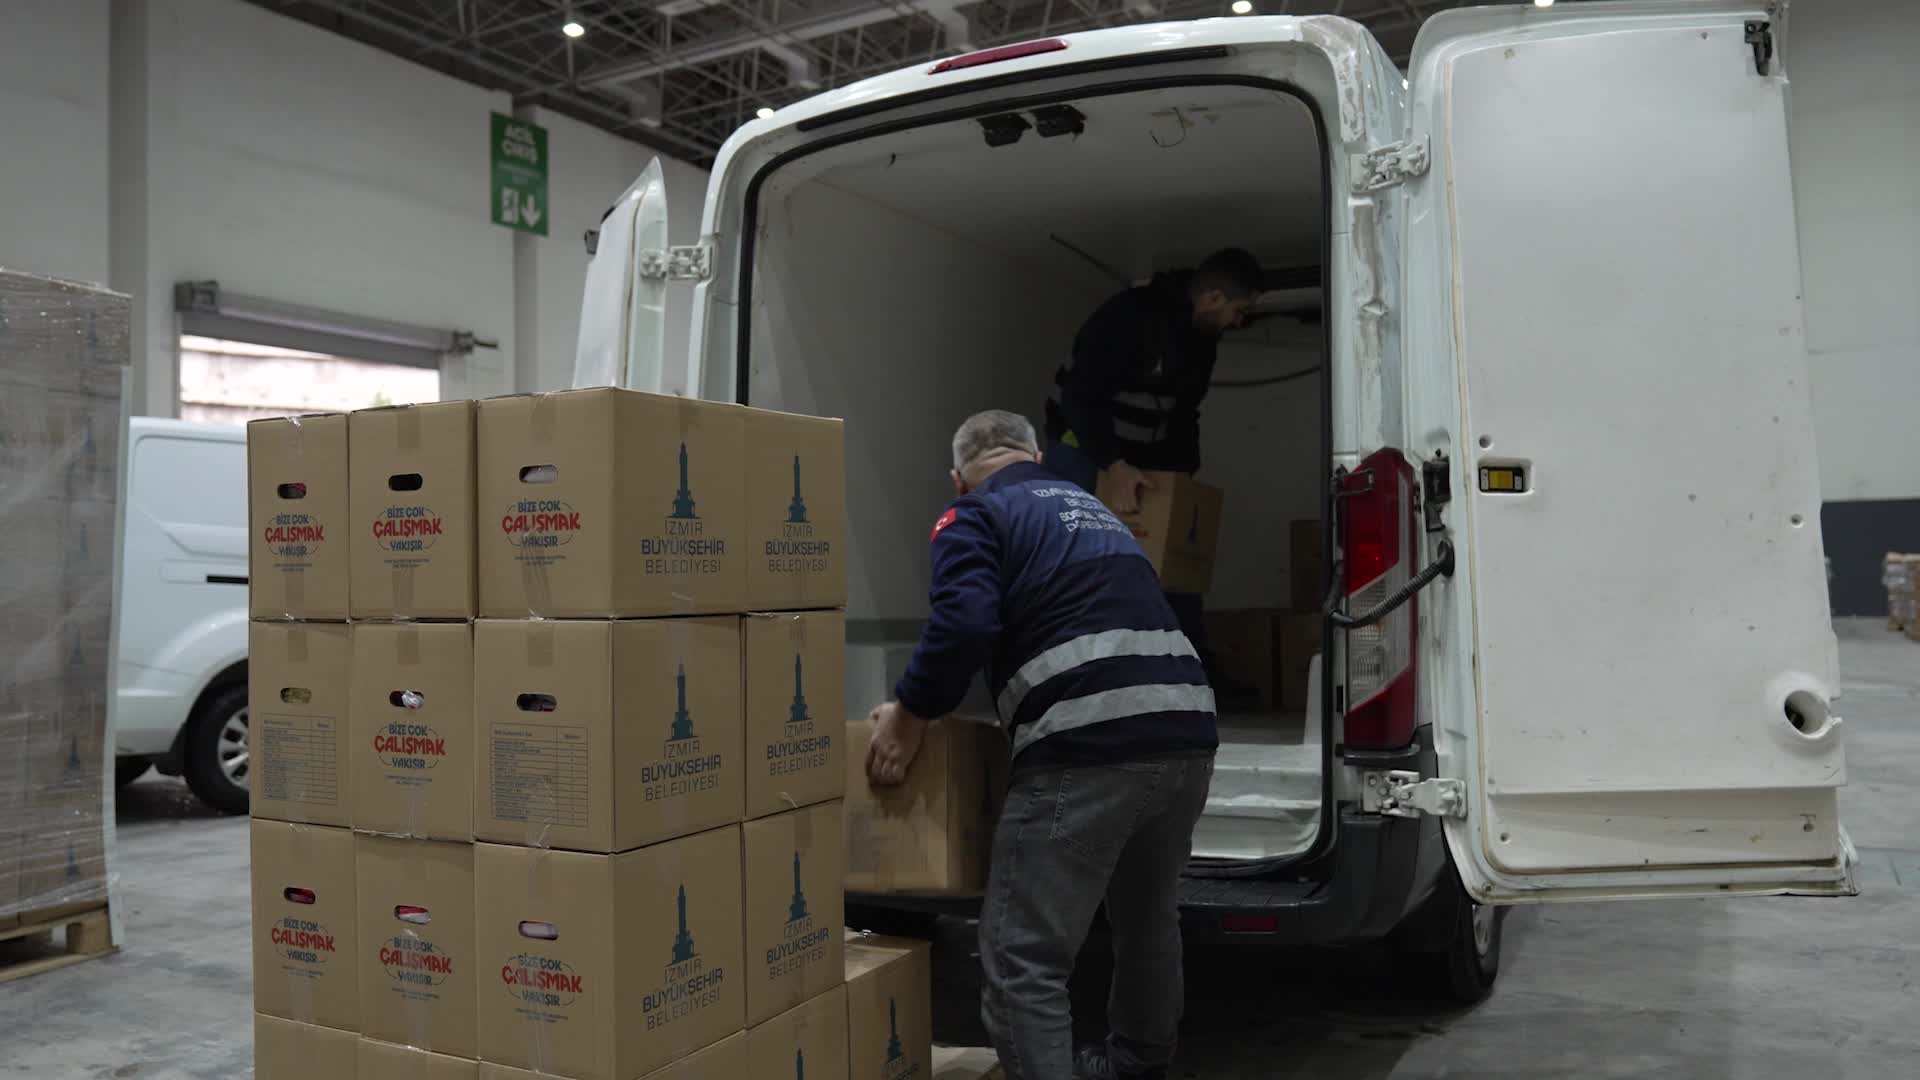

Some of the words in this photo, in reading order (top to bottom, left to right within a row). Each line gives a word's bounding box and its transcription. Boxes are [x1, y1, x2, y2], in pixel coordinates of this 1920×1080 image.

[641, 536, 725, 556] BÜYÜKŞEHİR
[765, 538, 830, 557] BÜYÜKŞEHİR
[767, 735, 831, 760] BÜYÜKŞEHİR
[641, 754, 721, 784] BÜYÜKŞEHİR
[642, 967, 724, 1014] BÜYÜKŞEHİR
